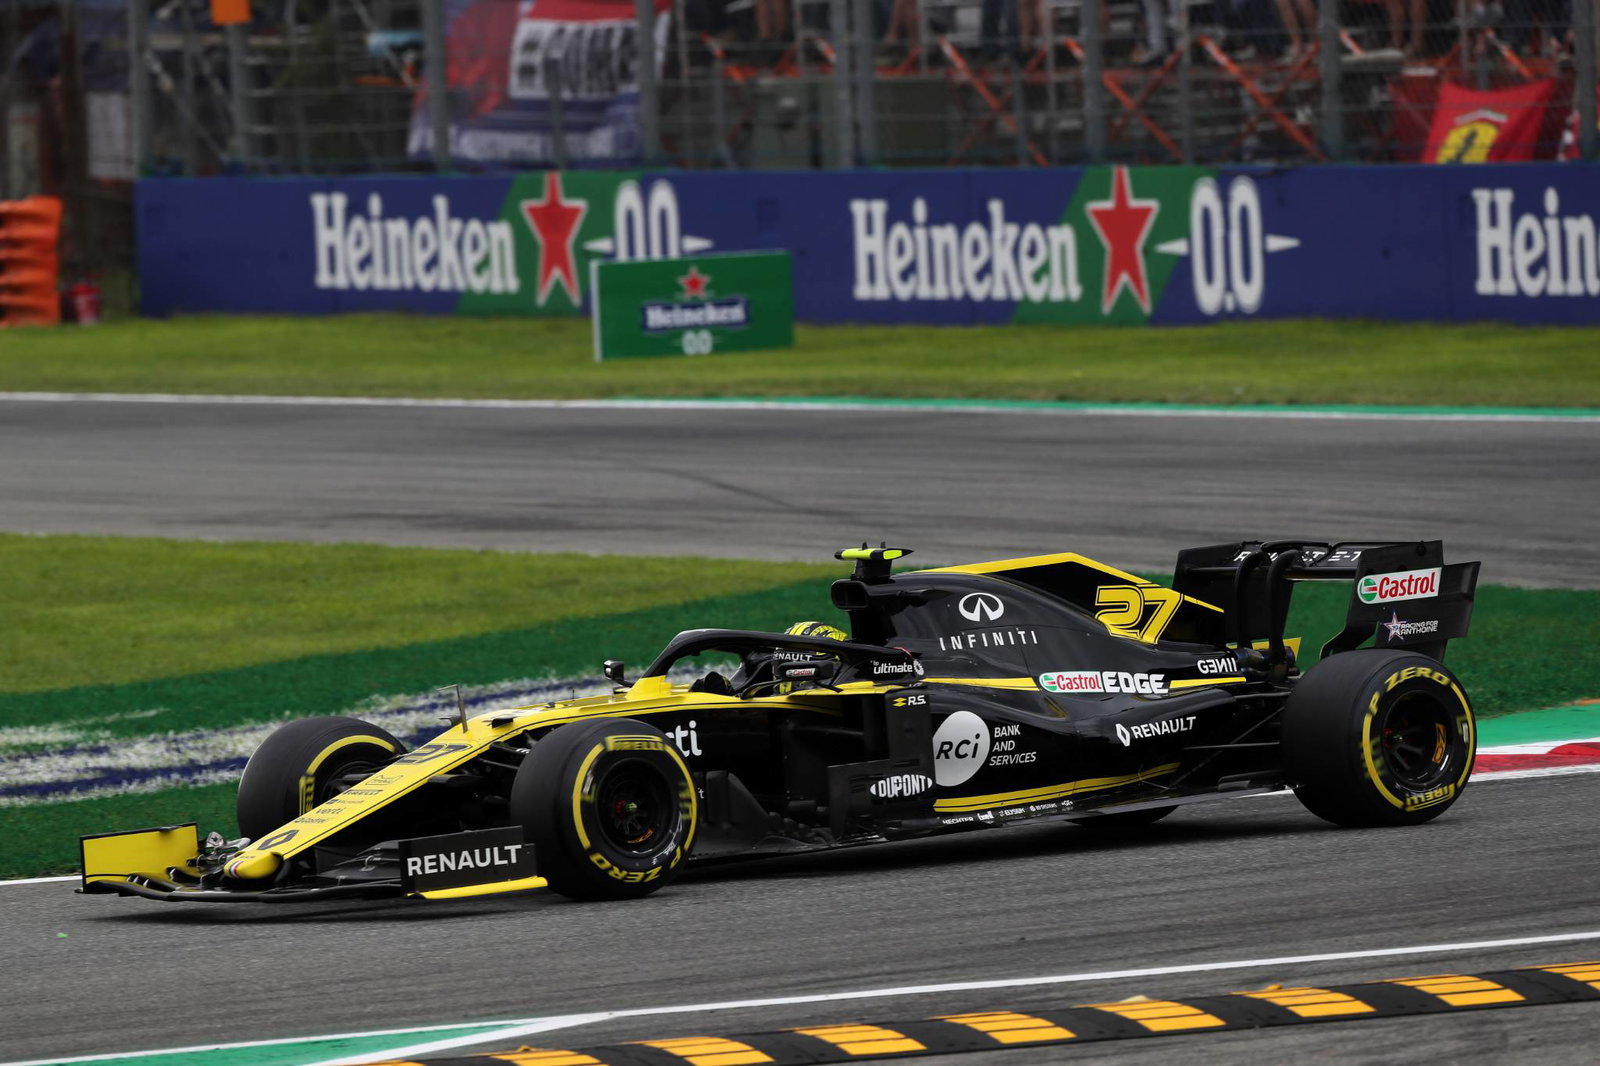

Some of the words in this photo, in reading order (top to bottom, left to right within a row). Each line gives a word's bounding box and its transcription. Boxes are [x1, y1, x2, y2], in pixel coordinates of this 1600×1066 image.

[310, 192, 520, 294] Heineken
[850, 197, 1083, 302] Heineken
[1191, 176, 1264, 315] 0.0
[1472, 187, 1600, 297] Hein
[645, 302, 747, 329] Heineken
[1378, 571, 1436, 599] Castrol
[1095, 583, 1184, 645] 27
[1401, 621, 1425, 630] RACING
[1426, 620, 1439, 628] FOR
[939, 630, 1039, 651] INFINITI
[873, 662, 913, 675] ultimate
[1384, 666, 1450, 693] ZERO
[1055, 674, 1102, 692] Castrol
[1102, 671, 1169, 694] EDGE
[994, 724, 1021, 738] BANK
[1130, 716, 1197, 740] RENAULT
[989, 752, 1037, 766] SERVICES
[992, 740, 1016, 753] AND
[878, 774, 927, 798] DUPONT
[406, 844, 523, 876] RENAULT
[588, 852, 662, 883] ZERO
